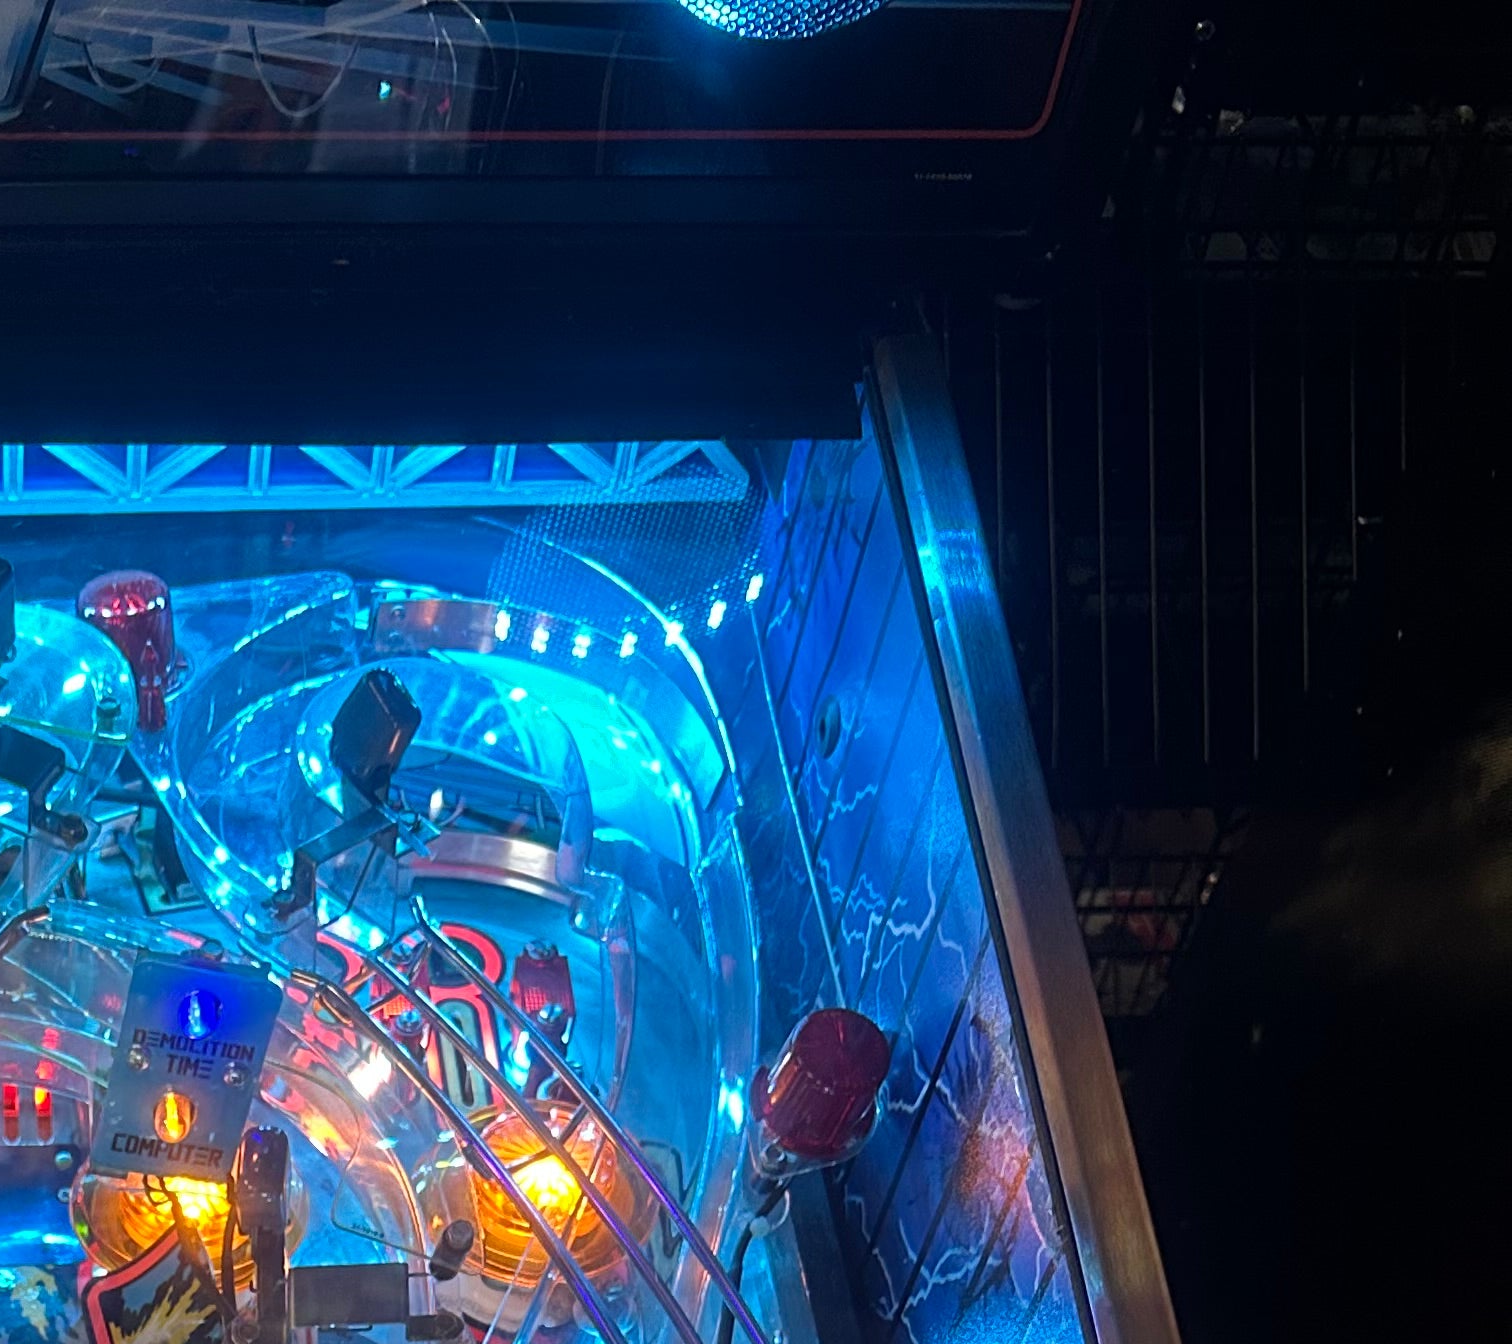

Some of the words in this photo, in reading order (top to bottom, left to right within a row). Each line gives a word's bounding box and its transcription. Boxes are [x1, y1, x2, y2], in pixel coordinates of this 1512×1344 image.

[132, 1029, 255, 1062] DEMOLITION
[166, 1054, 215, 1079] TIME
[111, 1133, 224, 1168] COMPUTER
